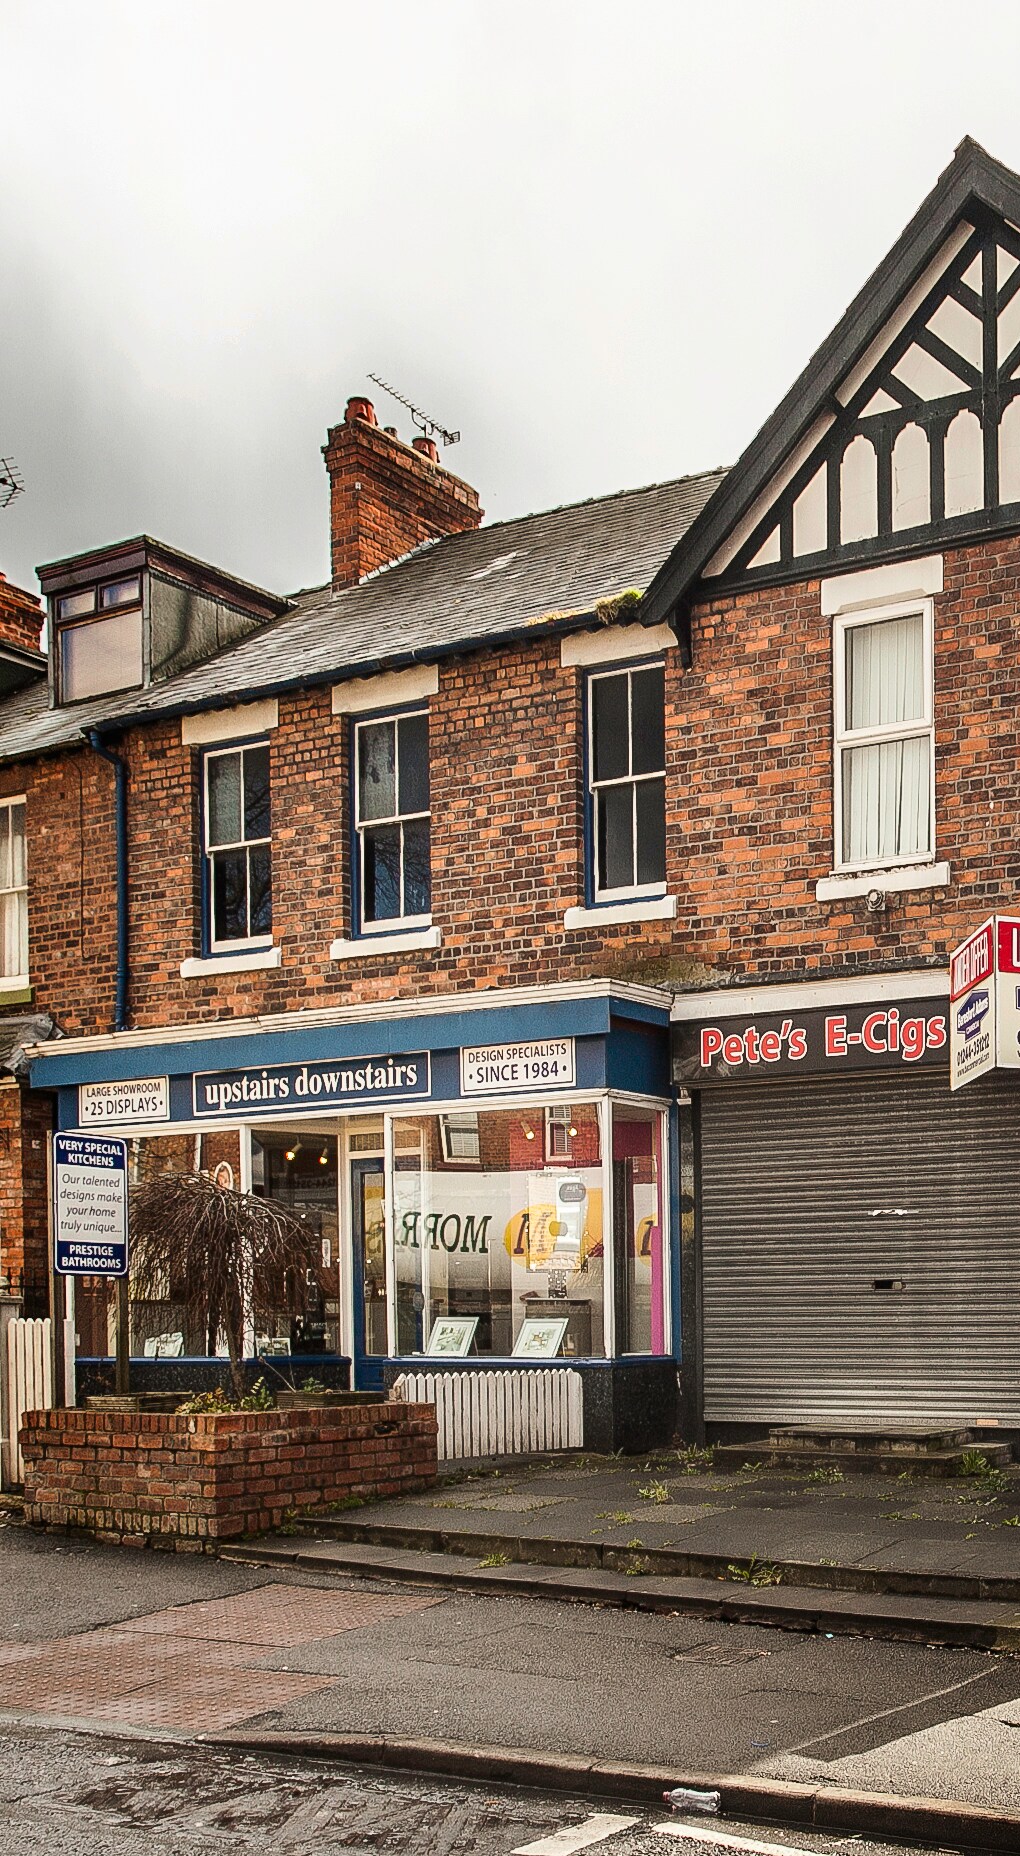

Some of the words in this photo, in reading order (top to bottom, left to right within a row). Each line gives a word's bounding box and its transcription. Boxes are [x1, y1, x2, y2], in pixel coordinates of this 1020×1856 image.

[970, 931, 988, 981] OFFER
[700, 1019, 807, 1067] Pete's
[825, 1007, 947, 1062] E-Cigs
[468, 1049, 504, 1064] DESIGN
[506, 1043, 567, 1060] SPECIALISTS
[476, 1064, 519, 1083] SINCE
[523, 1060, 559, 1079] 1984
[86, 1086, 111, 1098] LARGE
[113, 1082, 161, 1096] SHOWROOM
[205, 1071, 290, 1110] upstairs
[294, 1058, 418, 1096] downstairs
[90, 1102, 104, 1116] 25
[106, 1097, 158, 1115] DISPLAYS
[59, 1139, 83, 1152] VERY
[85, 1142, 122, 1156] SPECIAL
[68, 1153, 114, 1167] KITCHENS
[62, 1174, 80, 1184] Our
[83, 1175, 120, 1188] talented
[60, 1189, 95, 1203] designs
[97, 1190, 122, 1203] make
[66, 1205, 88, 1217] your
[89, 1205, 116, 1218] home
[60, 1220, 82, 1233] truly
[69, 1244, 114, 1256] PRESTIGE
[62, 1256, 121, 1269] BATHROOMS
